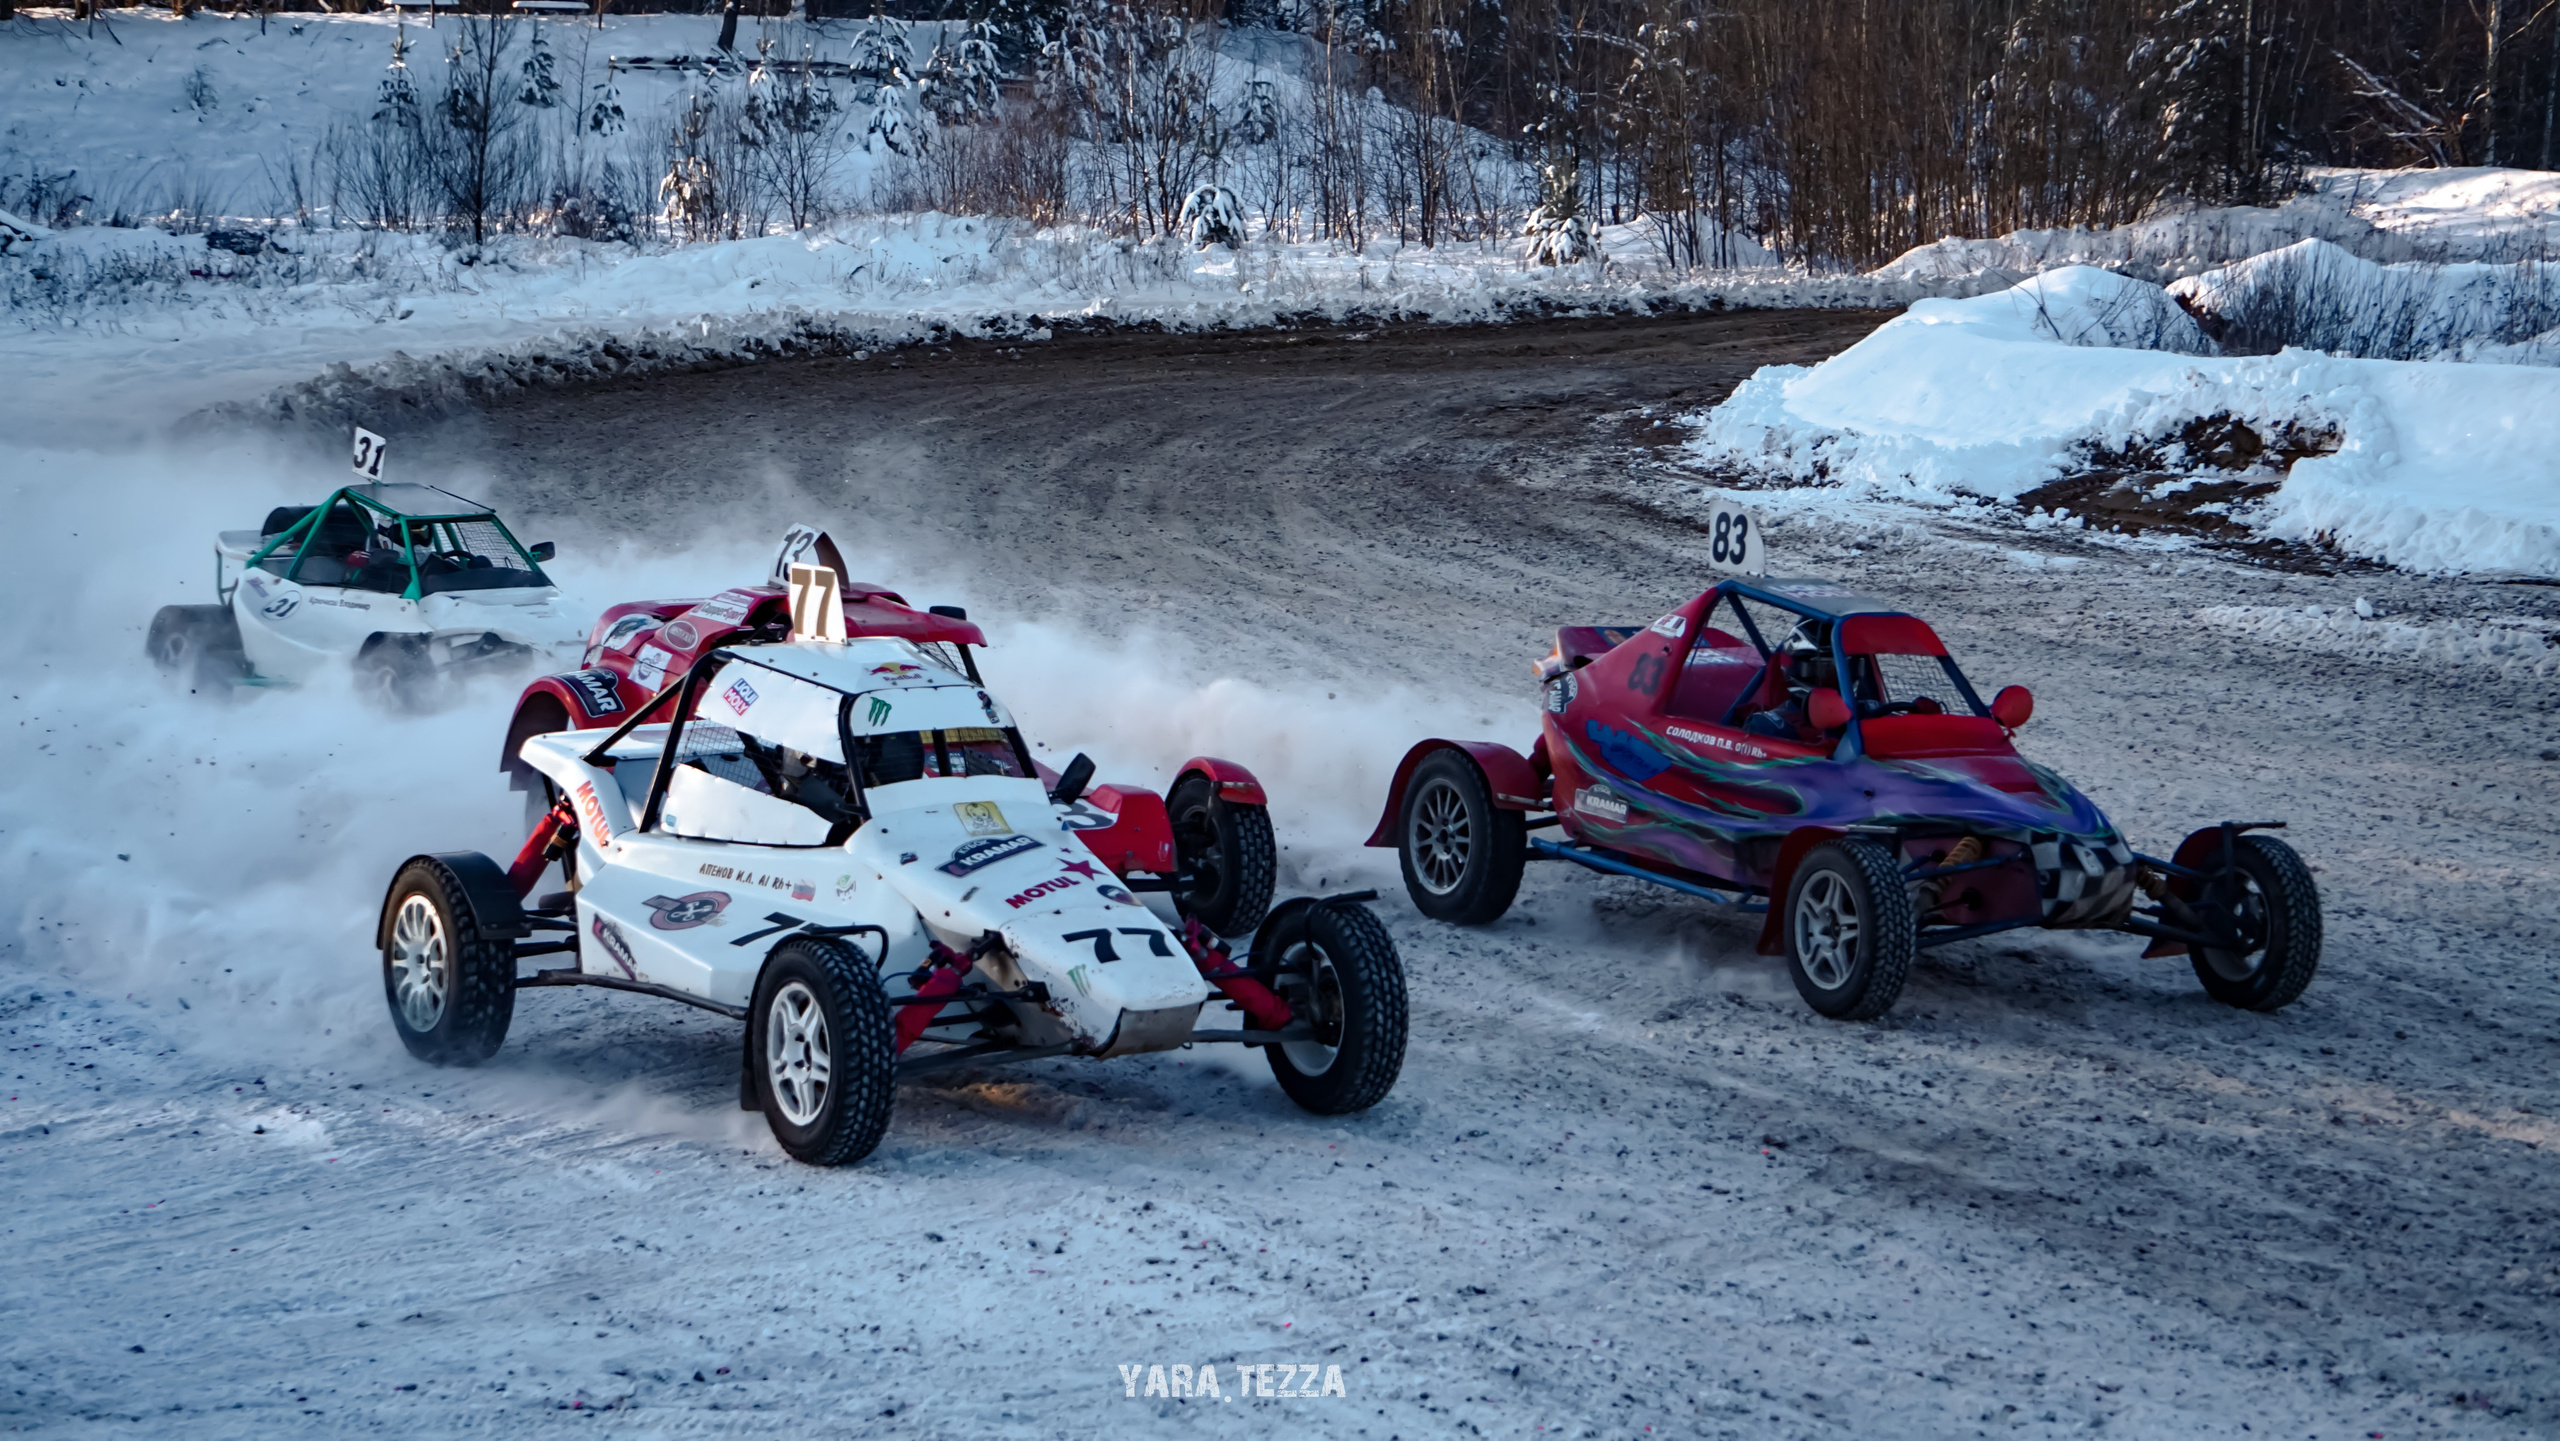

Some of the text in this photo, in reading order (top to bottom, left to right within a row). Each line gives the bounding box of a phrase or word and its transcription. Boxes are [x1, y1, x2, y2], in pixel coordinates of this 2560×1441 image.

[353, 436, 386, 476] 31
[775, 528, 815, 582] 13
[1712, 512, 1748, 565] 83
[264, 598, 300, 618] 31
[791, 567, 836, 637] 77
[724, 688, 750, 714] MOLY
[733, 680, 759, 705] LIQUI
[1665, 725, 1716, 746] СОЛОДКОВ
[1716, 738, 1733, 751] П.В.
[576, 780, 611, 848] MOTUL
[1586, 795, 1627, 815] KRAMAR
[960, 837, 1032, 866] KRAMAR
[1005, 876, 1081, 909] MOTUL
[1061, 927, 1176, 964] 77
